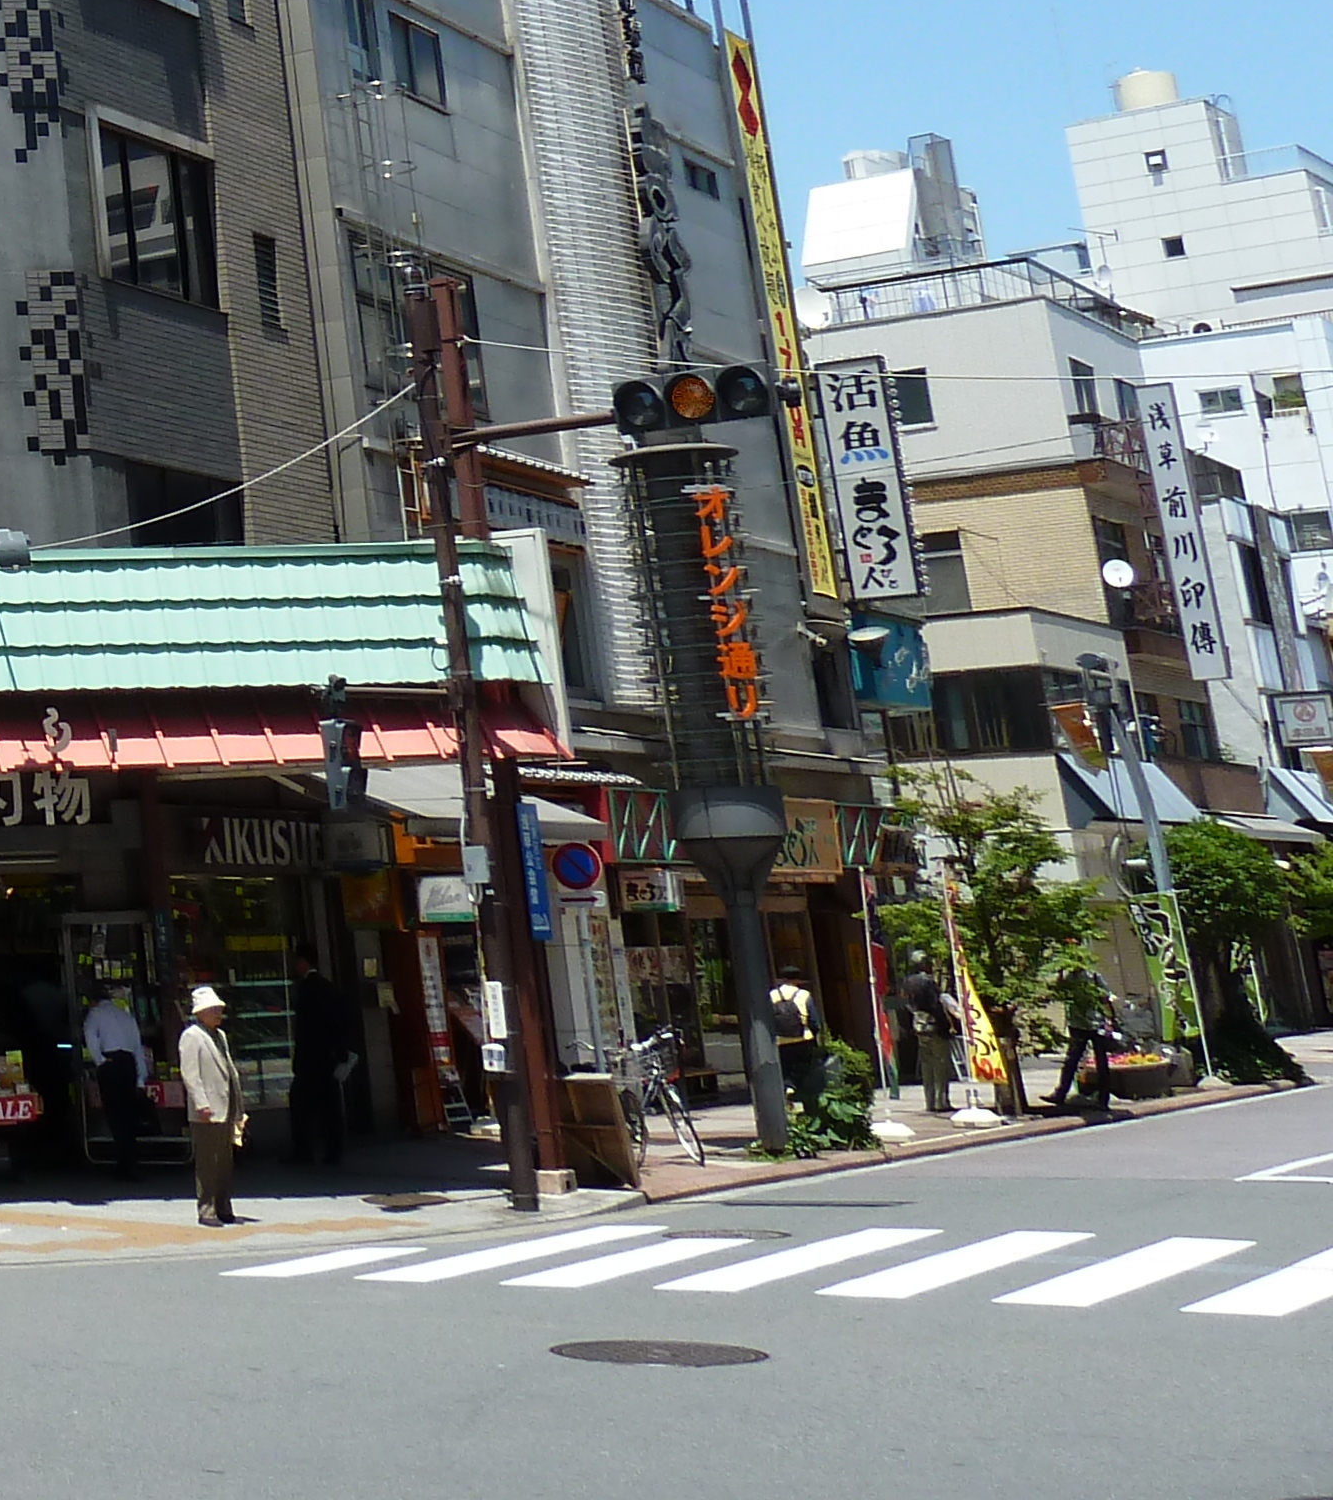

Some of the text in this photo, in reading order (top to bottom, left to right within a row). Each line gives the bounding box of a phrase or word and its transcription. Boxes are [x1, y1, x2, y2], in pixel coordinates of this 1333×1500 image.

[825, 368, 889, 465] 活魚
[691, 485, 759, 719] オレンジ通り
[201, 816, 324, 868] KIKUSUE
